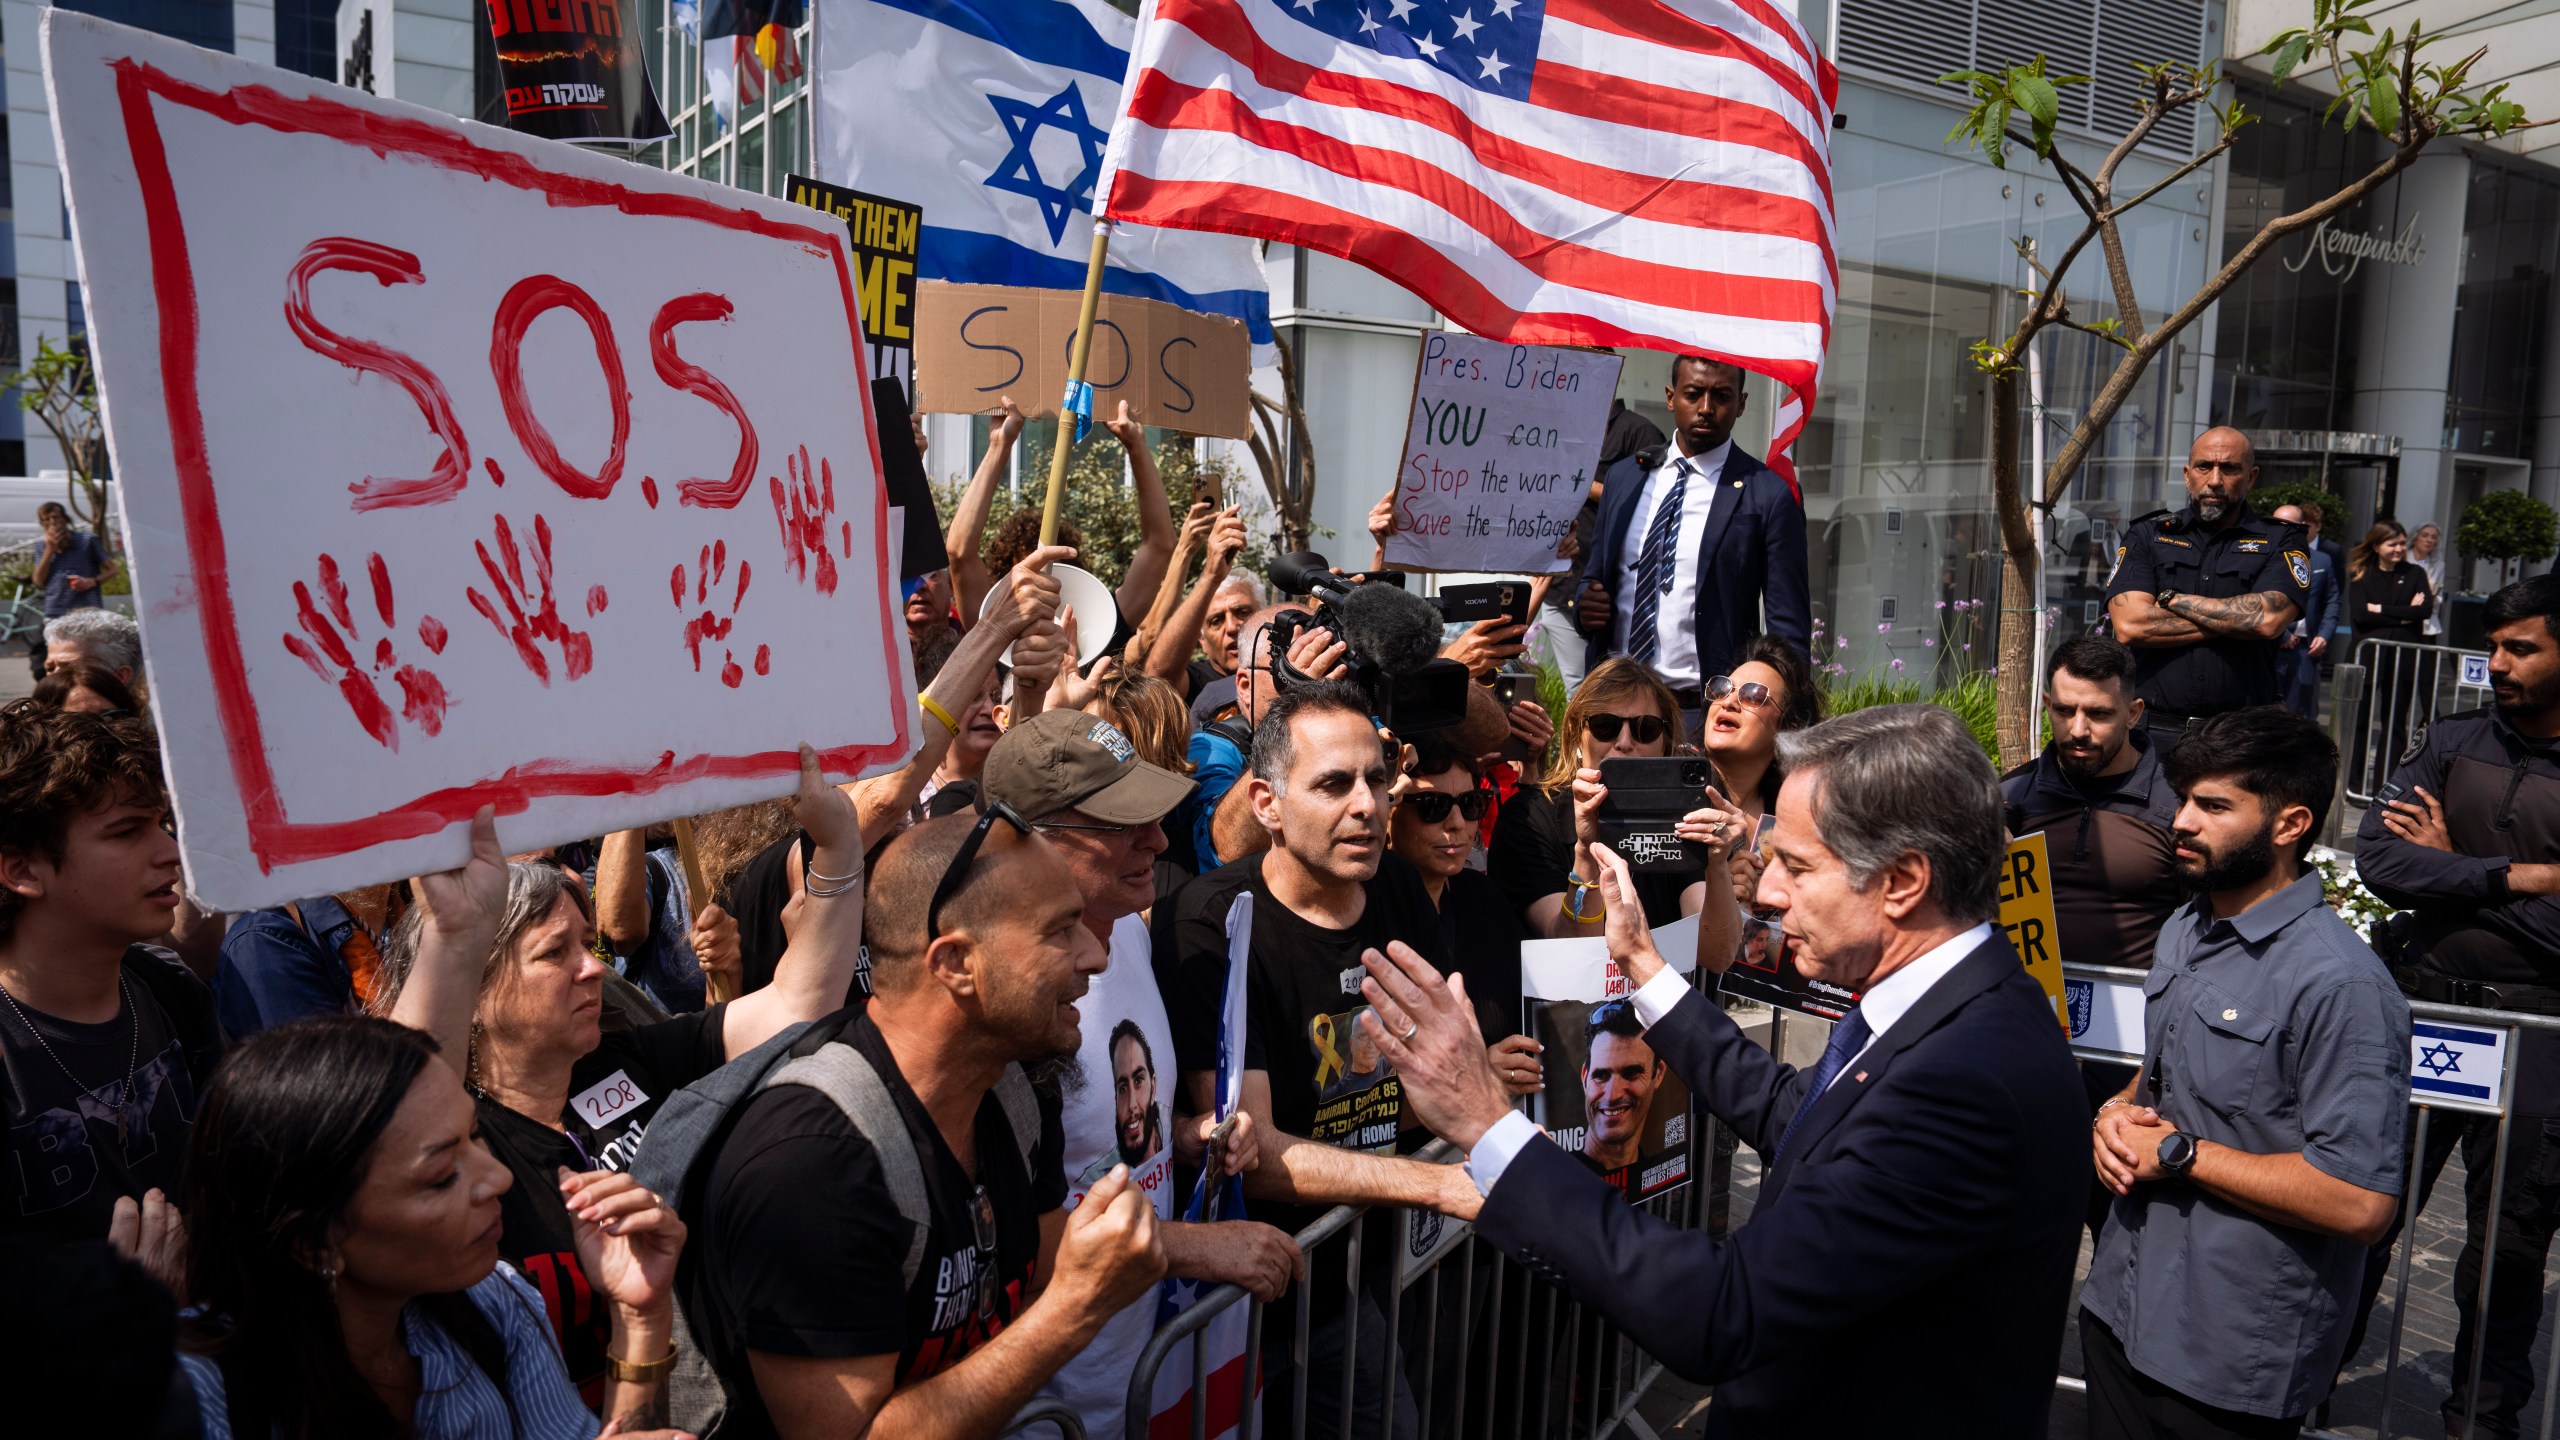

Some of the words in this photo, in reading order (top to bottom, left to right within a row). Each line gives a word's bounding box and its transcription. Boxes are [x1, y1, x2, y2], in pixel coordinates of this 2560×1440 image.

[852, 198, 918, 255] THEM
[2283, 211, 2428, 284] Kempinski
[852, 250, 914, 340] ME
[284, 236, 759, 513] S.O.S
[1424, 336, 1488, 382] Pres.
[1505, 344, 1579, 393] Biden
[1421, 396, 1487, 447] YOU
[1510, 424, 1559, 449] can
[1406, 453, 1469, 500] Stop
[1481, 459, 1508, 494] the
[1519, 472, 1562, 494] war
[1396, 496, 1452, 537] Save
[1466, 504, 1491, 538] the
[1507, 504, 1570, 550] hostage
[586, 1080, 636, 1118] 208
[1314, 1099, 1351, 1123] AMIRAM
[1383, 1081, 1398, 1098] 85
[1311, 1125, 1326, 1139] 85
[1361, 1121, 1397, 1145] HOME
[1642, 1169, 1666, 1190] FAMILIES
[1666, 1161, 1686, 1180] FORUM
